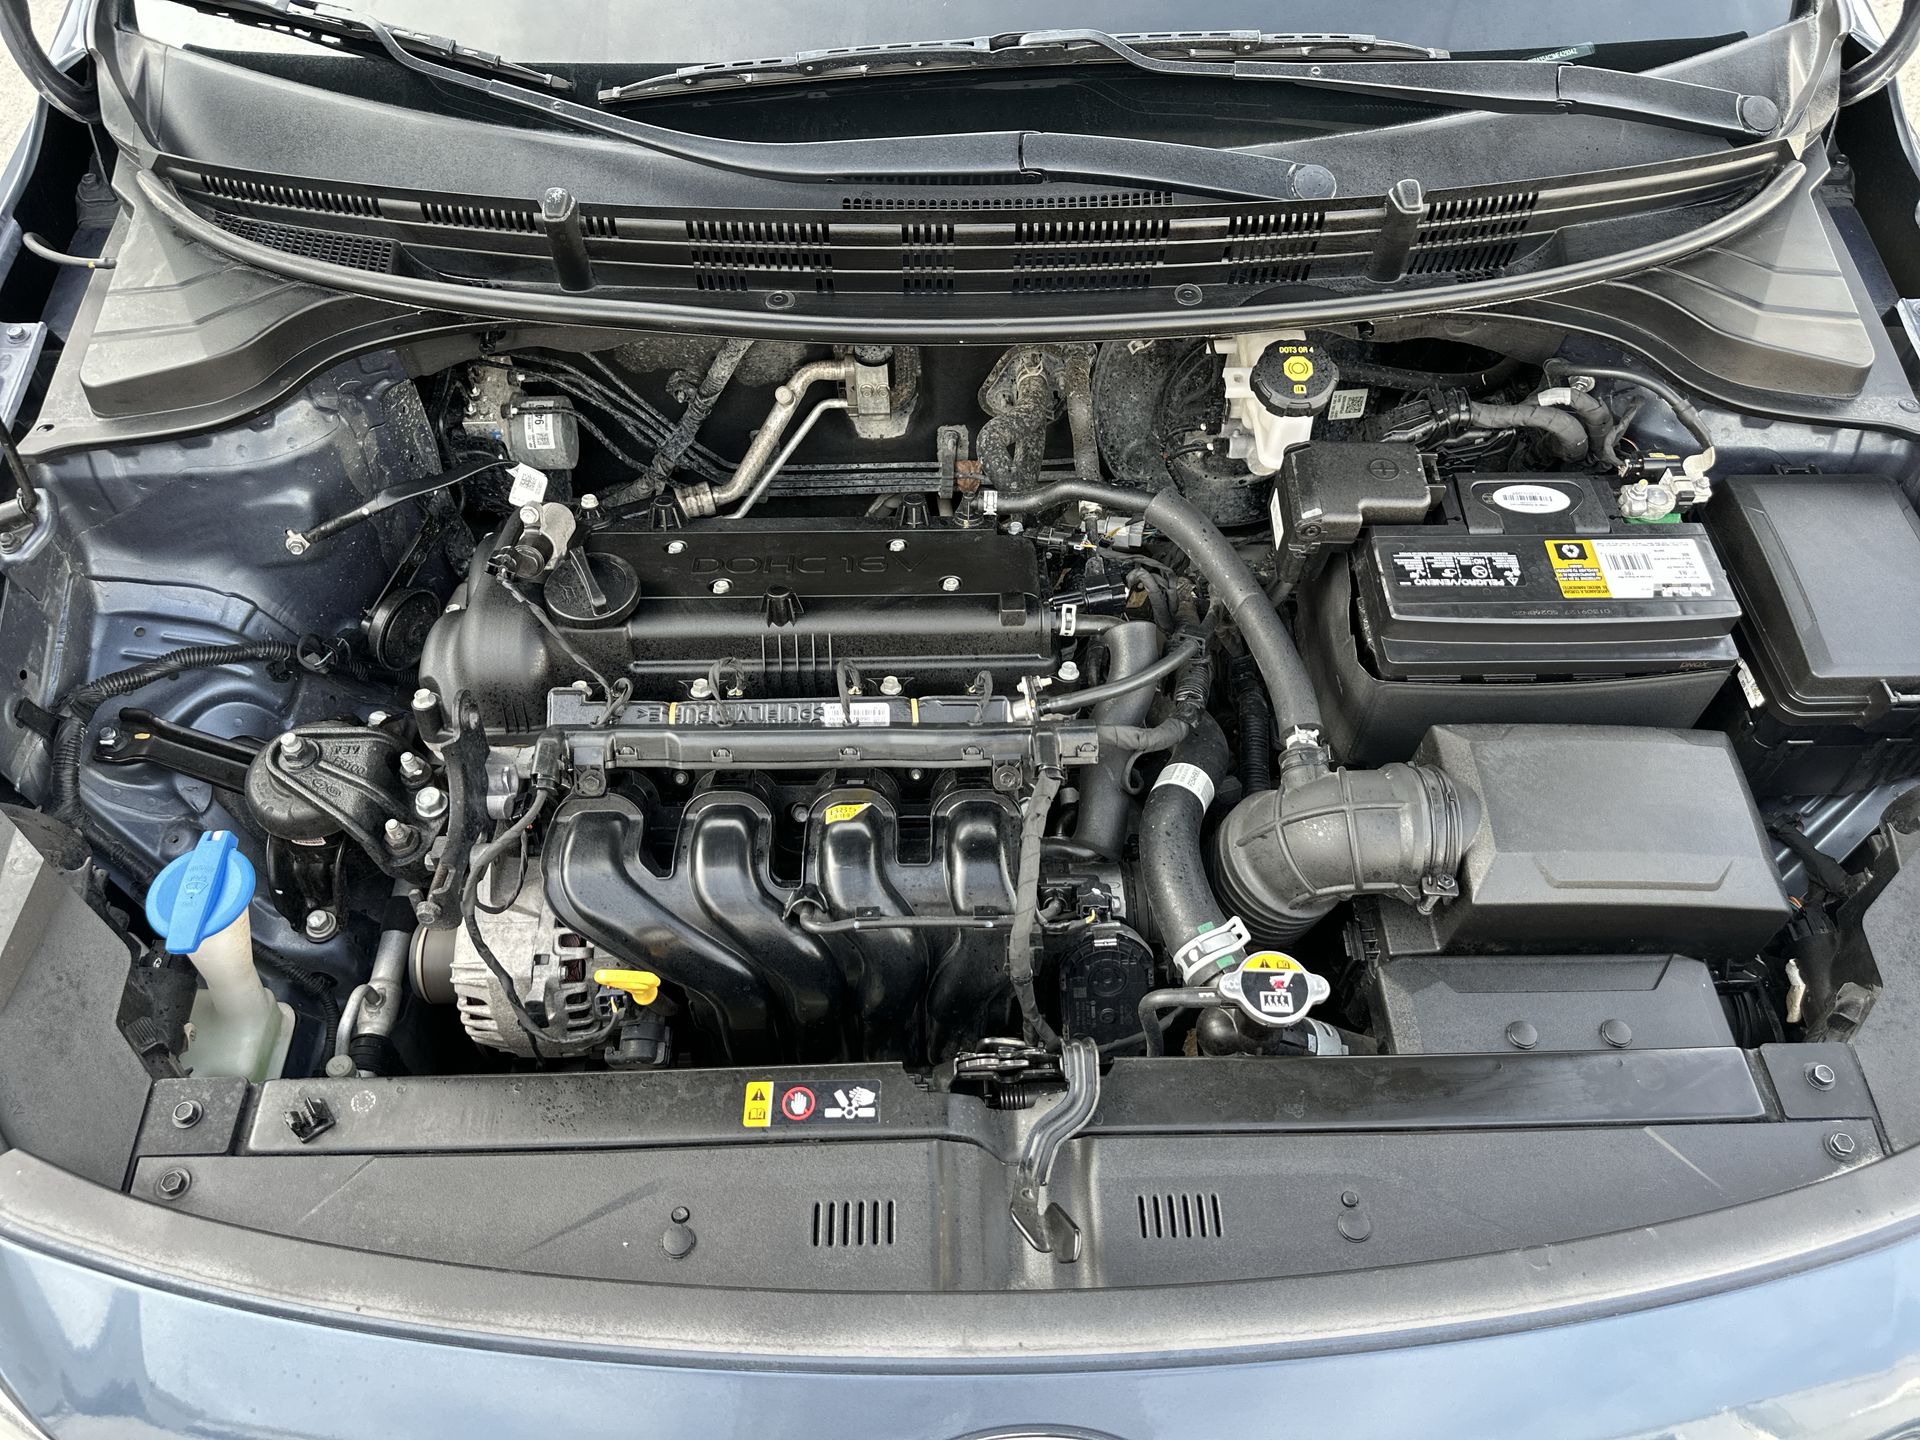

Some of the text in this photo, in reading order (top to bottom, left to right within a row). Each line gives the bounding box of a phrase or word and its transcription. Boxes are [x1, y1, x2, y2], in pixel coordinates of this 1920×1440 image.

[1278, 346, 1297, 354] DOT3
[1298, 346, 1308, 354] OR
[689, 552, 828, 575] DOHC
